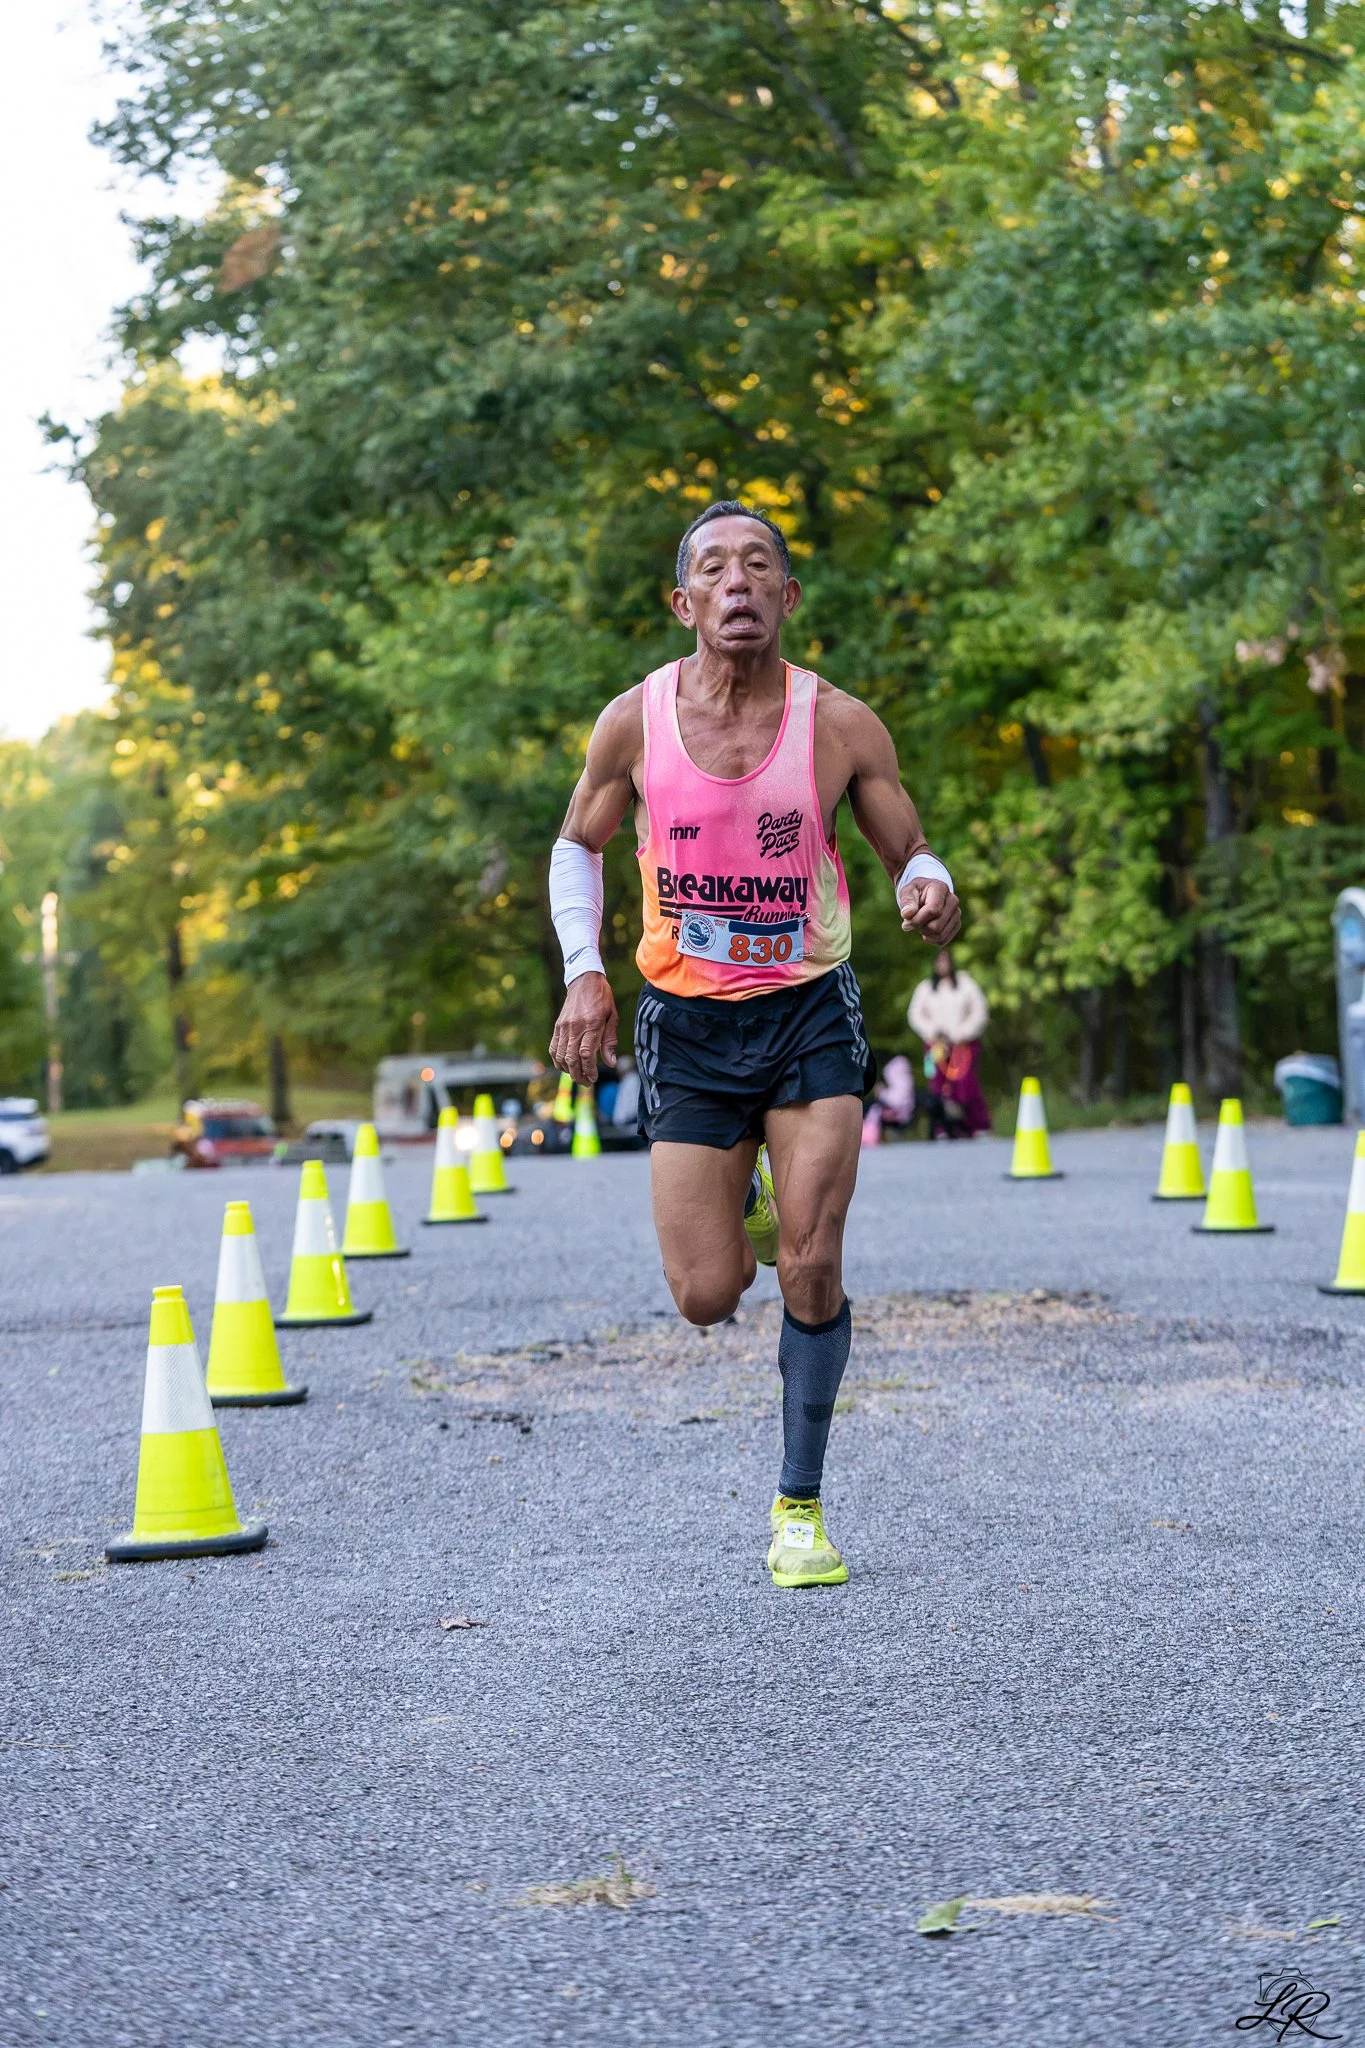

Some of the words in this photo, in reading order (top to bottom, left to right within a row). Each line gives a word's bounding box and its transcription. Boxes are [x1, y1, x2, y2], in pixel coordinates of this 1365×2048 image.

[669, 826, 701, 840] mnr
[756, 809, 803, 840] Party
[760, 831, 800, 859] Pace
[657, 866, 808, 911] Breakaway
[728, 934, 793, 964] 830
